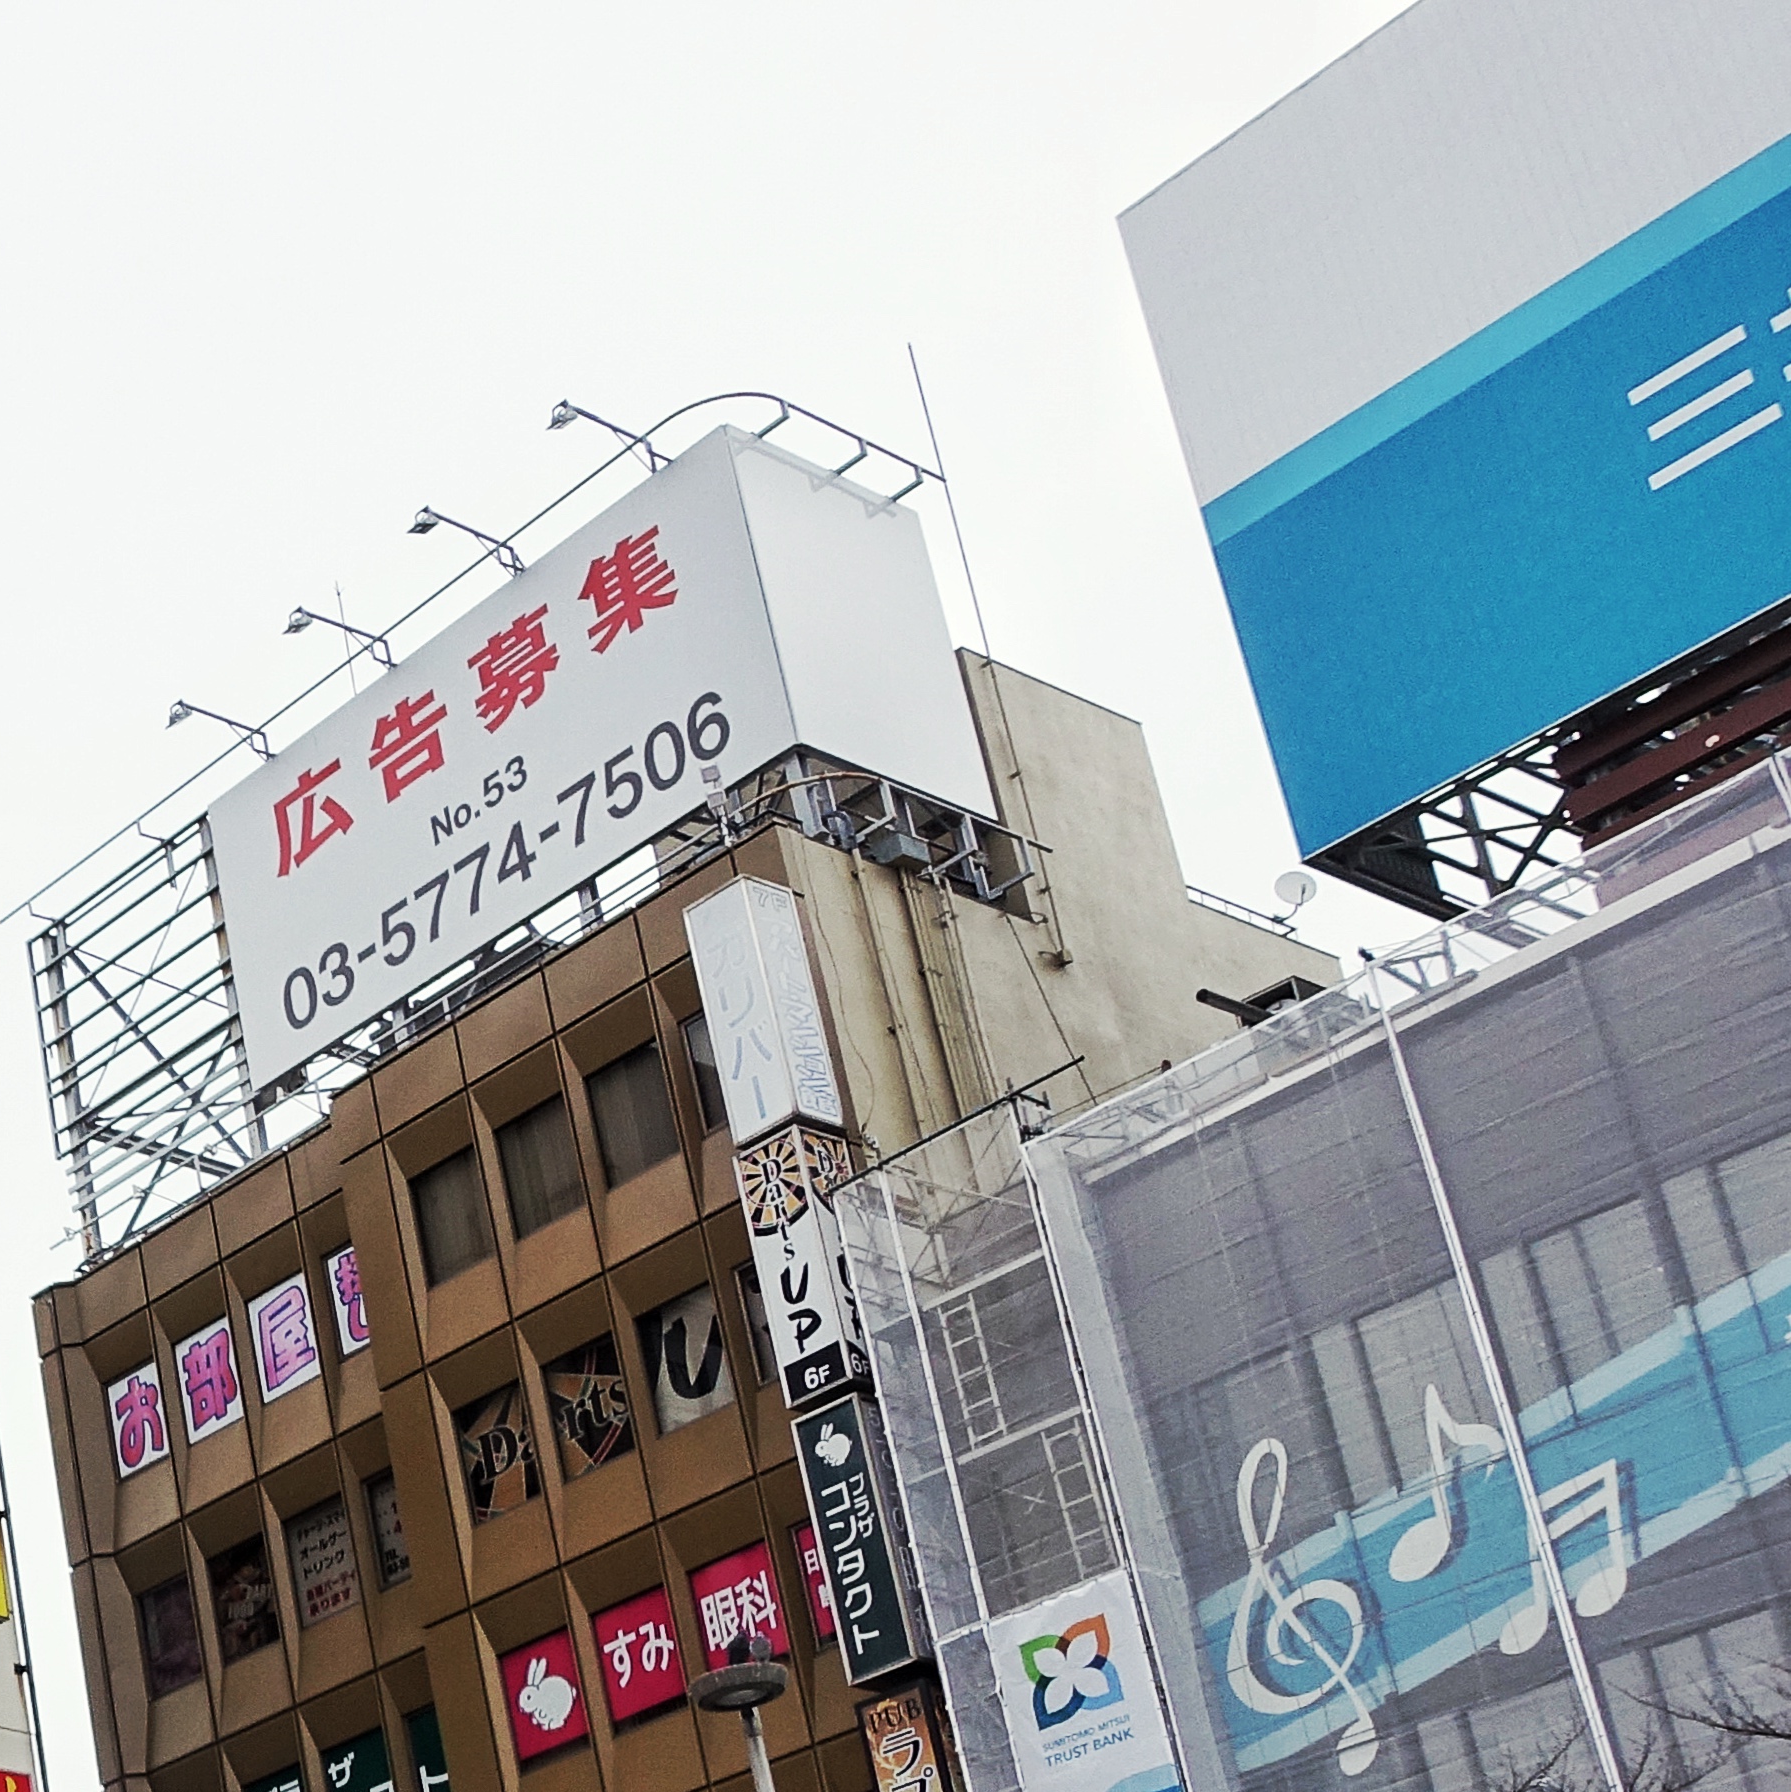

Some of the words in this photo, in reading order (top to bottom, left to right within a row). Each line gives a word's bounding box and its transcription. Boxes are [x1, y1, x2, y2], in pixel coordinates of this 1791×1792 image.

[273, 525, 678, 878] 広告募集
[430, 755, 529, 846] No.53
[282, 691, 731, 1030] 03-5774-7506
[761, 1158, 795, 1261] Darts
[780, 1262, 822, 1354] UP
[804, 1365, 830, 1390] 6F
[849, 1472, 875, 1538] プラザ
[821, 1481, 880, 1655] コンタクト
[603, 1621, 675, 1689] すみ
[698, 1569, 779, 1654] 眼科
[869, 1698, 921, 1734] PUB
[1045, 1740, 1093, 1769] TRUST
